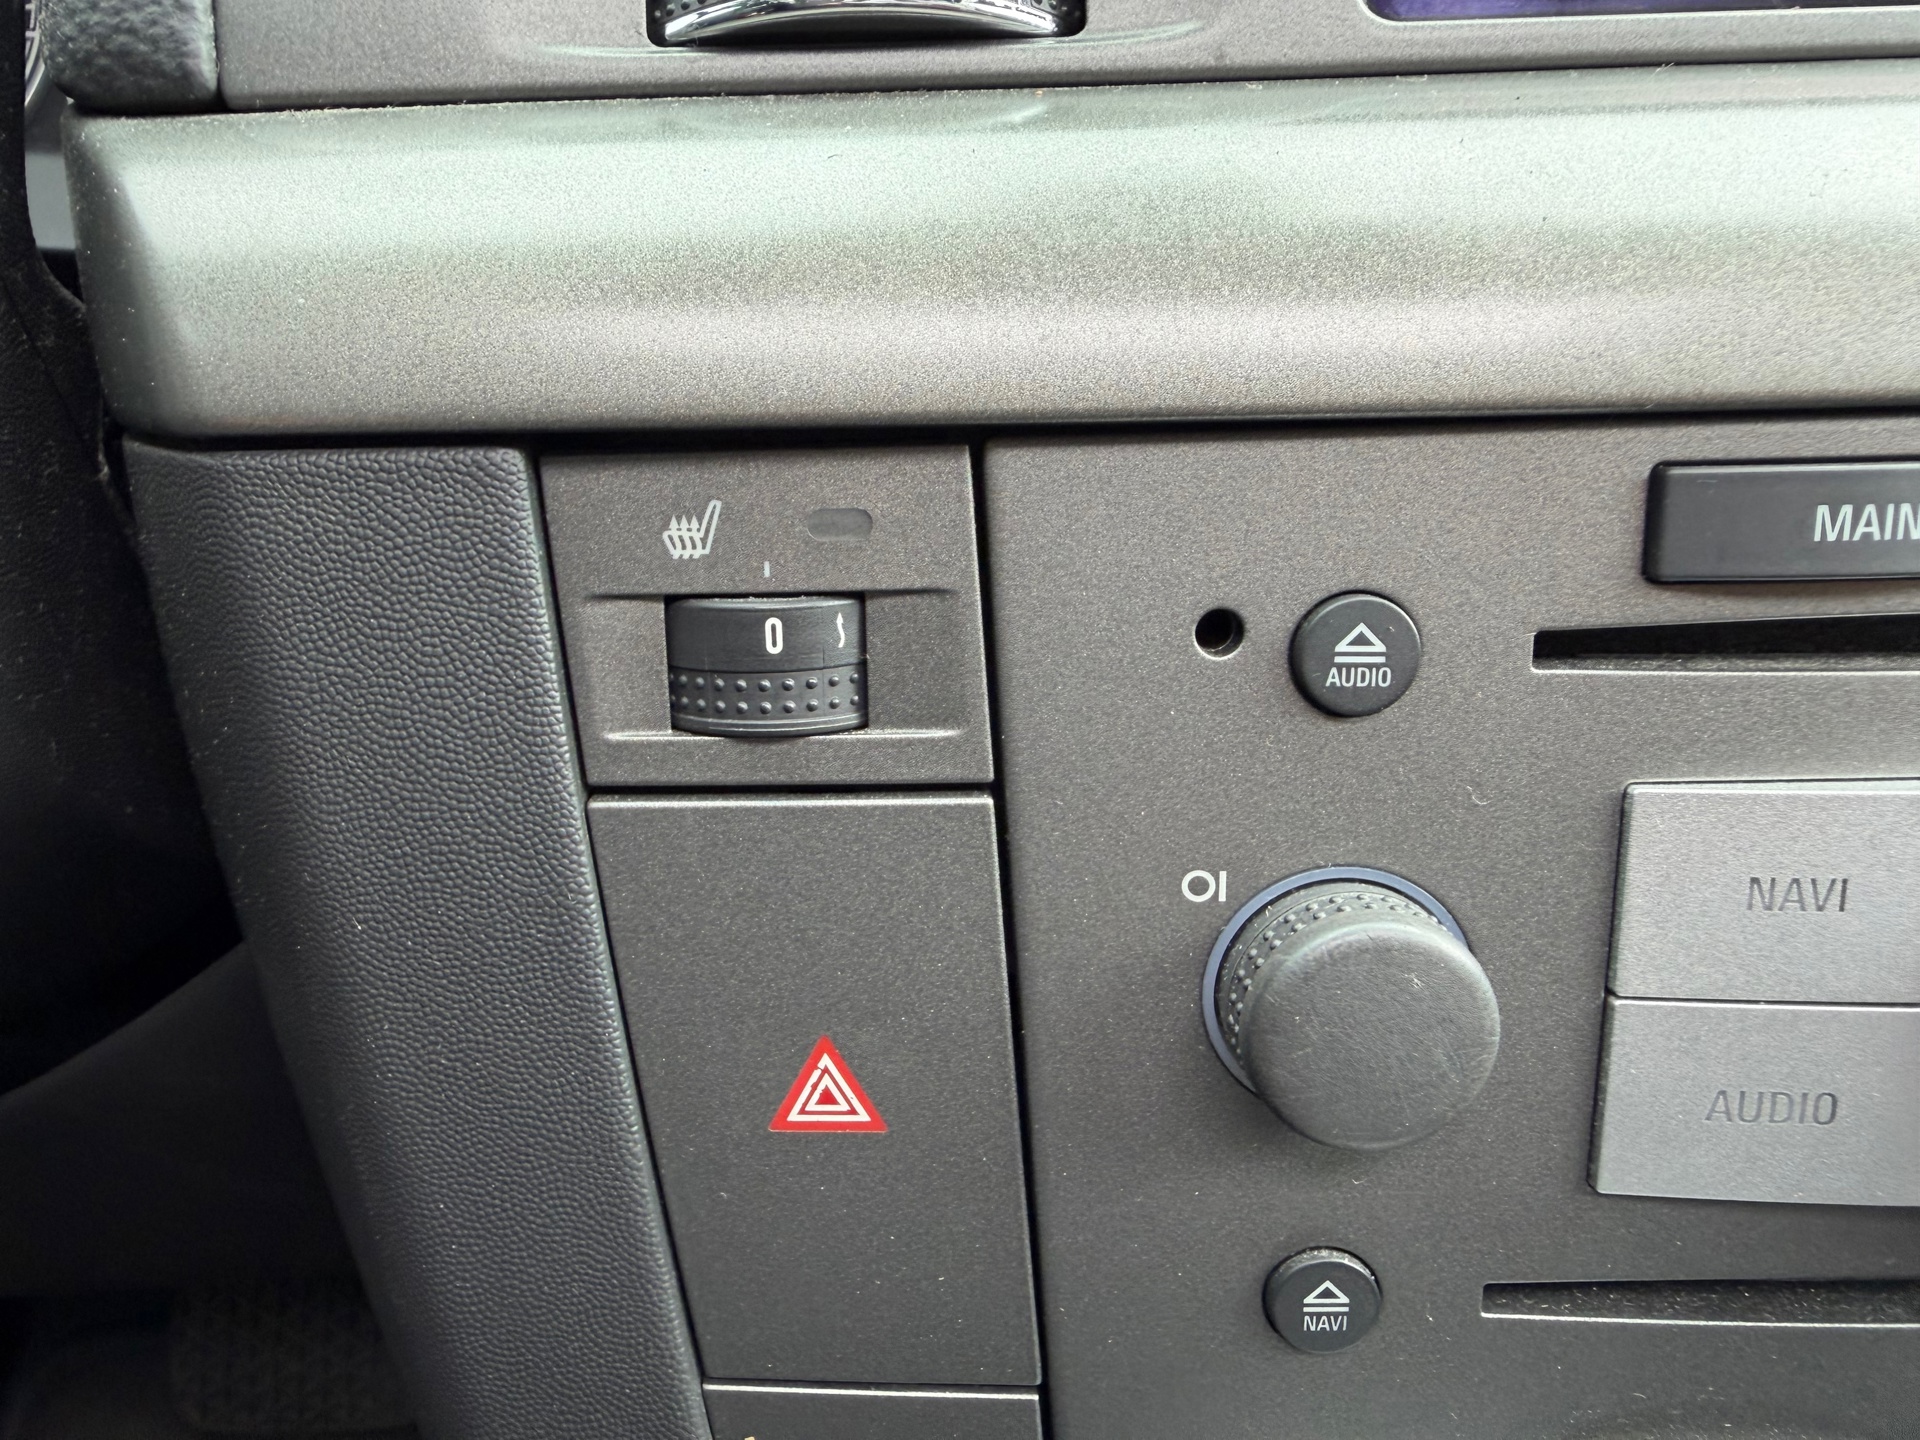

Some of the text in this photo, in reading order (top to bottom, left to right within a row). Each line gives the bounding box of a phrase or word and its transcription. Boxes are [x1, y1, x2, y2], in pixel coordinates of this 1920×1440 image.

[1813, 503, 1920, 541] MAIN
[1325, 666, 1392, 687] AUDIO
[1746, 876, 1849, 912] NAVI
[1704, 1089, 1838, 1125] AUDIO
[1303, 1315, 1348, 1331] NAVI
